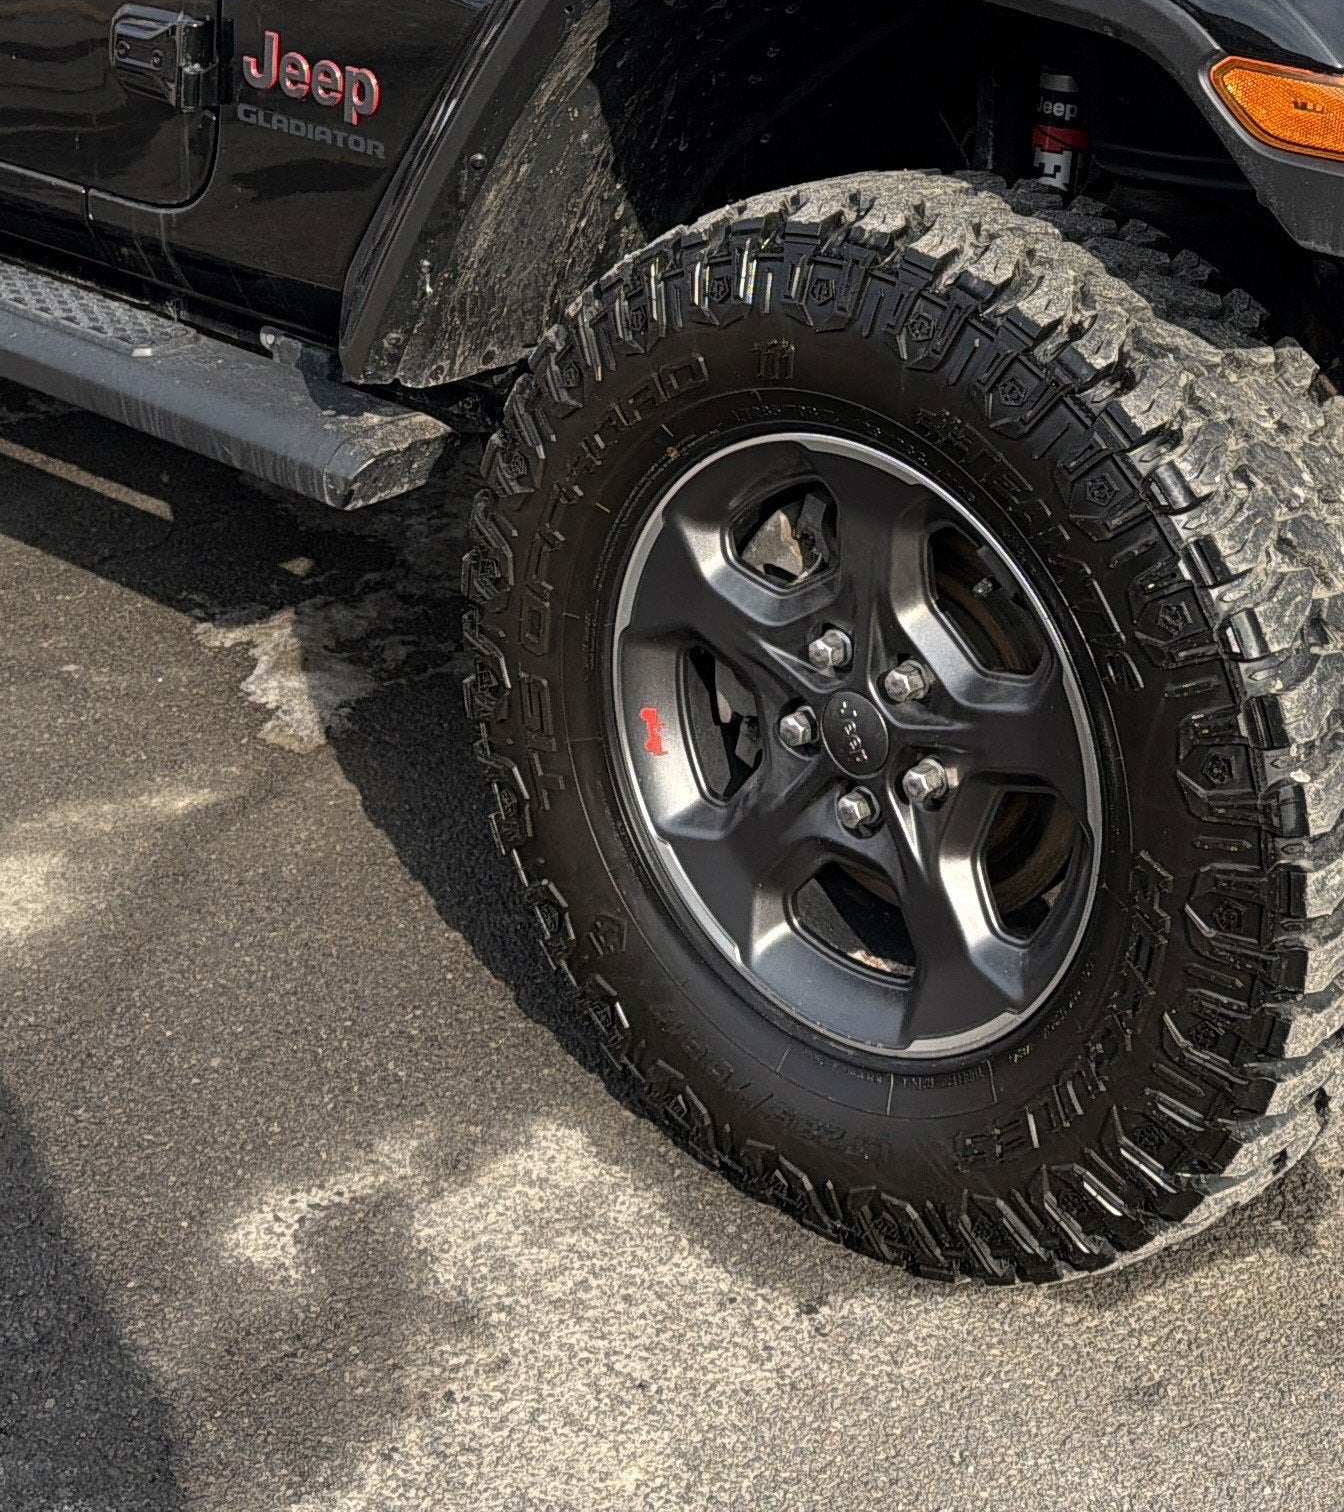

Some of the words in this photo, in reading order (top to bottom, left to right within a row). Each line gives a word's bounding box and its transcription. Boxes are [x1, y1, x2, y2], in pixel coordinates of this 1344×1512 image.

[242, 30, 381, 126] Jeep
[237, 102, 386, 160] GLADIATOR
[1036, 95, 1078, 121] Jeep
